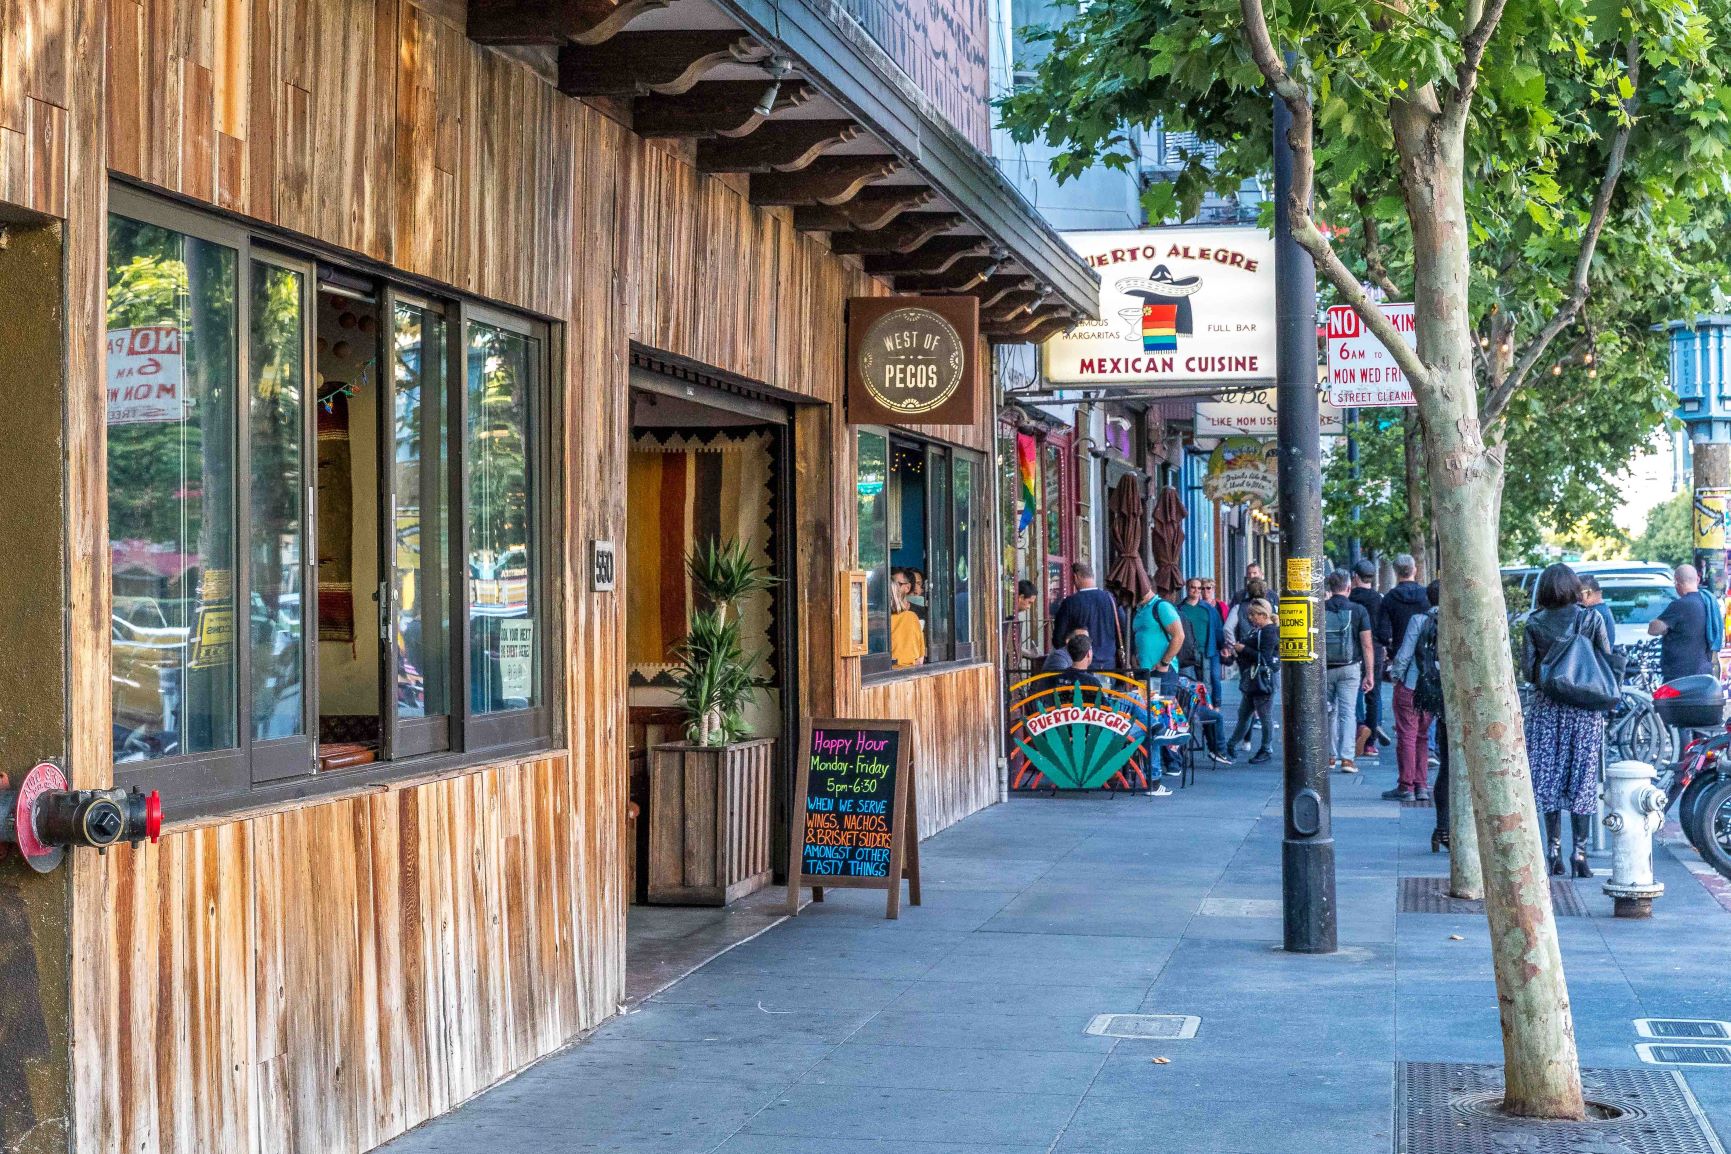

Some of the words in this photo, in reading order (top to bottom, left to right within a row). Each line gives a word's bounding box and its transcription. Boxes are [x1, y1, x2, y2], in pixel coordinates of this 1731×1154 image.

[1084, 245, 1157, 268] UERTO
[1167, 243, 1259, 273] ALEGRE
[1207, 324, 1232, 332] FULL
[1236, 323, 1256, 332] BAR
[1331, 309, 1356, 335] NO
[883, 331, 918, 352] WEST
[923, 333, 941, 351] OF
[1063, 331, 1120, 340] MARGARITAS
[1080, 357, 1174, 374] MEXICAN
[1185, 356, 1259, 373] CUISINE
[885, 364, 937, 388] PECOS
[1334, 369, 1356, 384] MON
[1360, 368, 1380, 383] WED
[1385, 367, 1401, 382] FRI
[1338, 392, 1371, 403] STREET
[1236, 417, 1256, 426] MOM
[1260, 417, 1277, 426] USE
[596, 550, 614, 584] 550
[1029, 709, 1080, 733] PUERTO
[1082, 707, 1130, 733] ALEGRE
[814, 730, 853, 755] Happy
[855, 730, 889, 754] Hour
[807, 796, 834, 811] WHEN
[839, 799, 853, 812] WE
[857, 799, 888, 814] SERVE
[806, 812, 840, 829] WINGS,
[805, 828, 816, 843] &
[816, 828, 859, 847] BRISKET
[804, 844, 853, 859] AMONGST
[855, 847, 890, 863] OTHER
[806, 859, 844, 875] TASTY
[847, 860, 887, 877] THINGS
